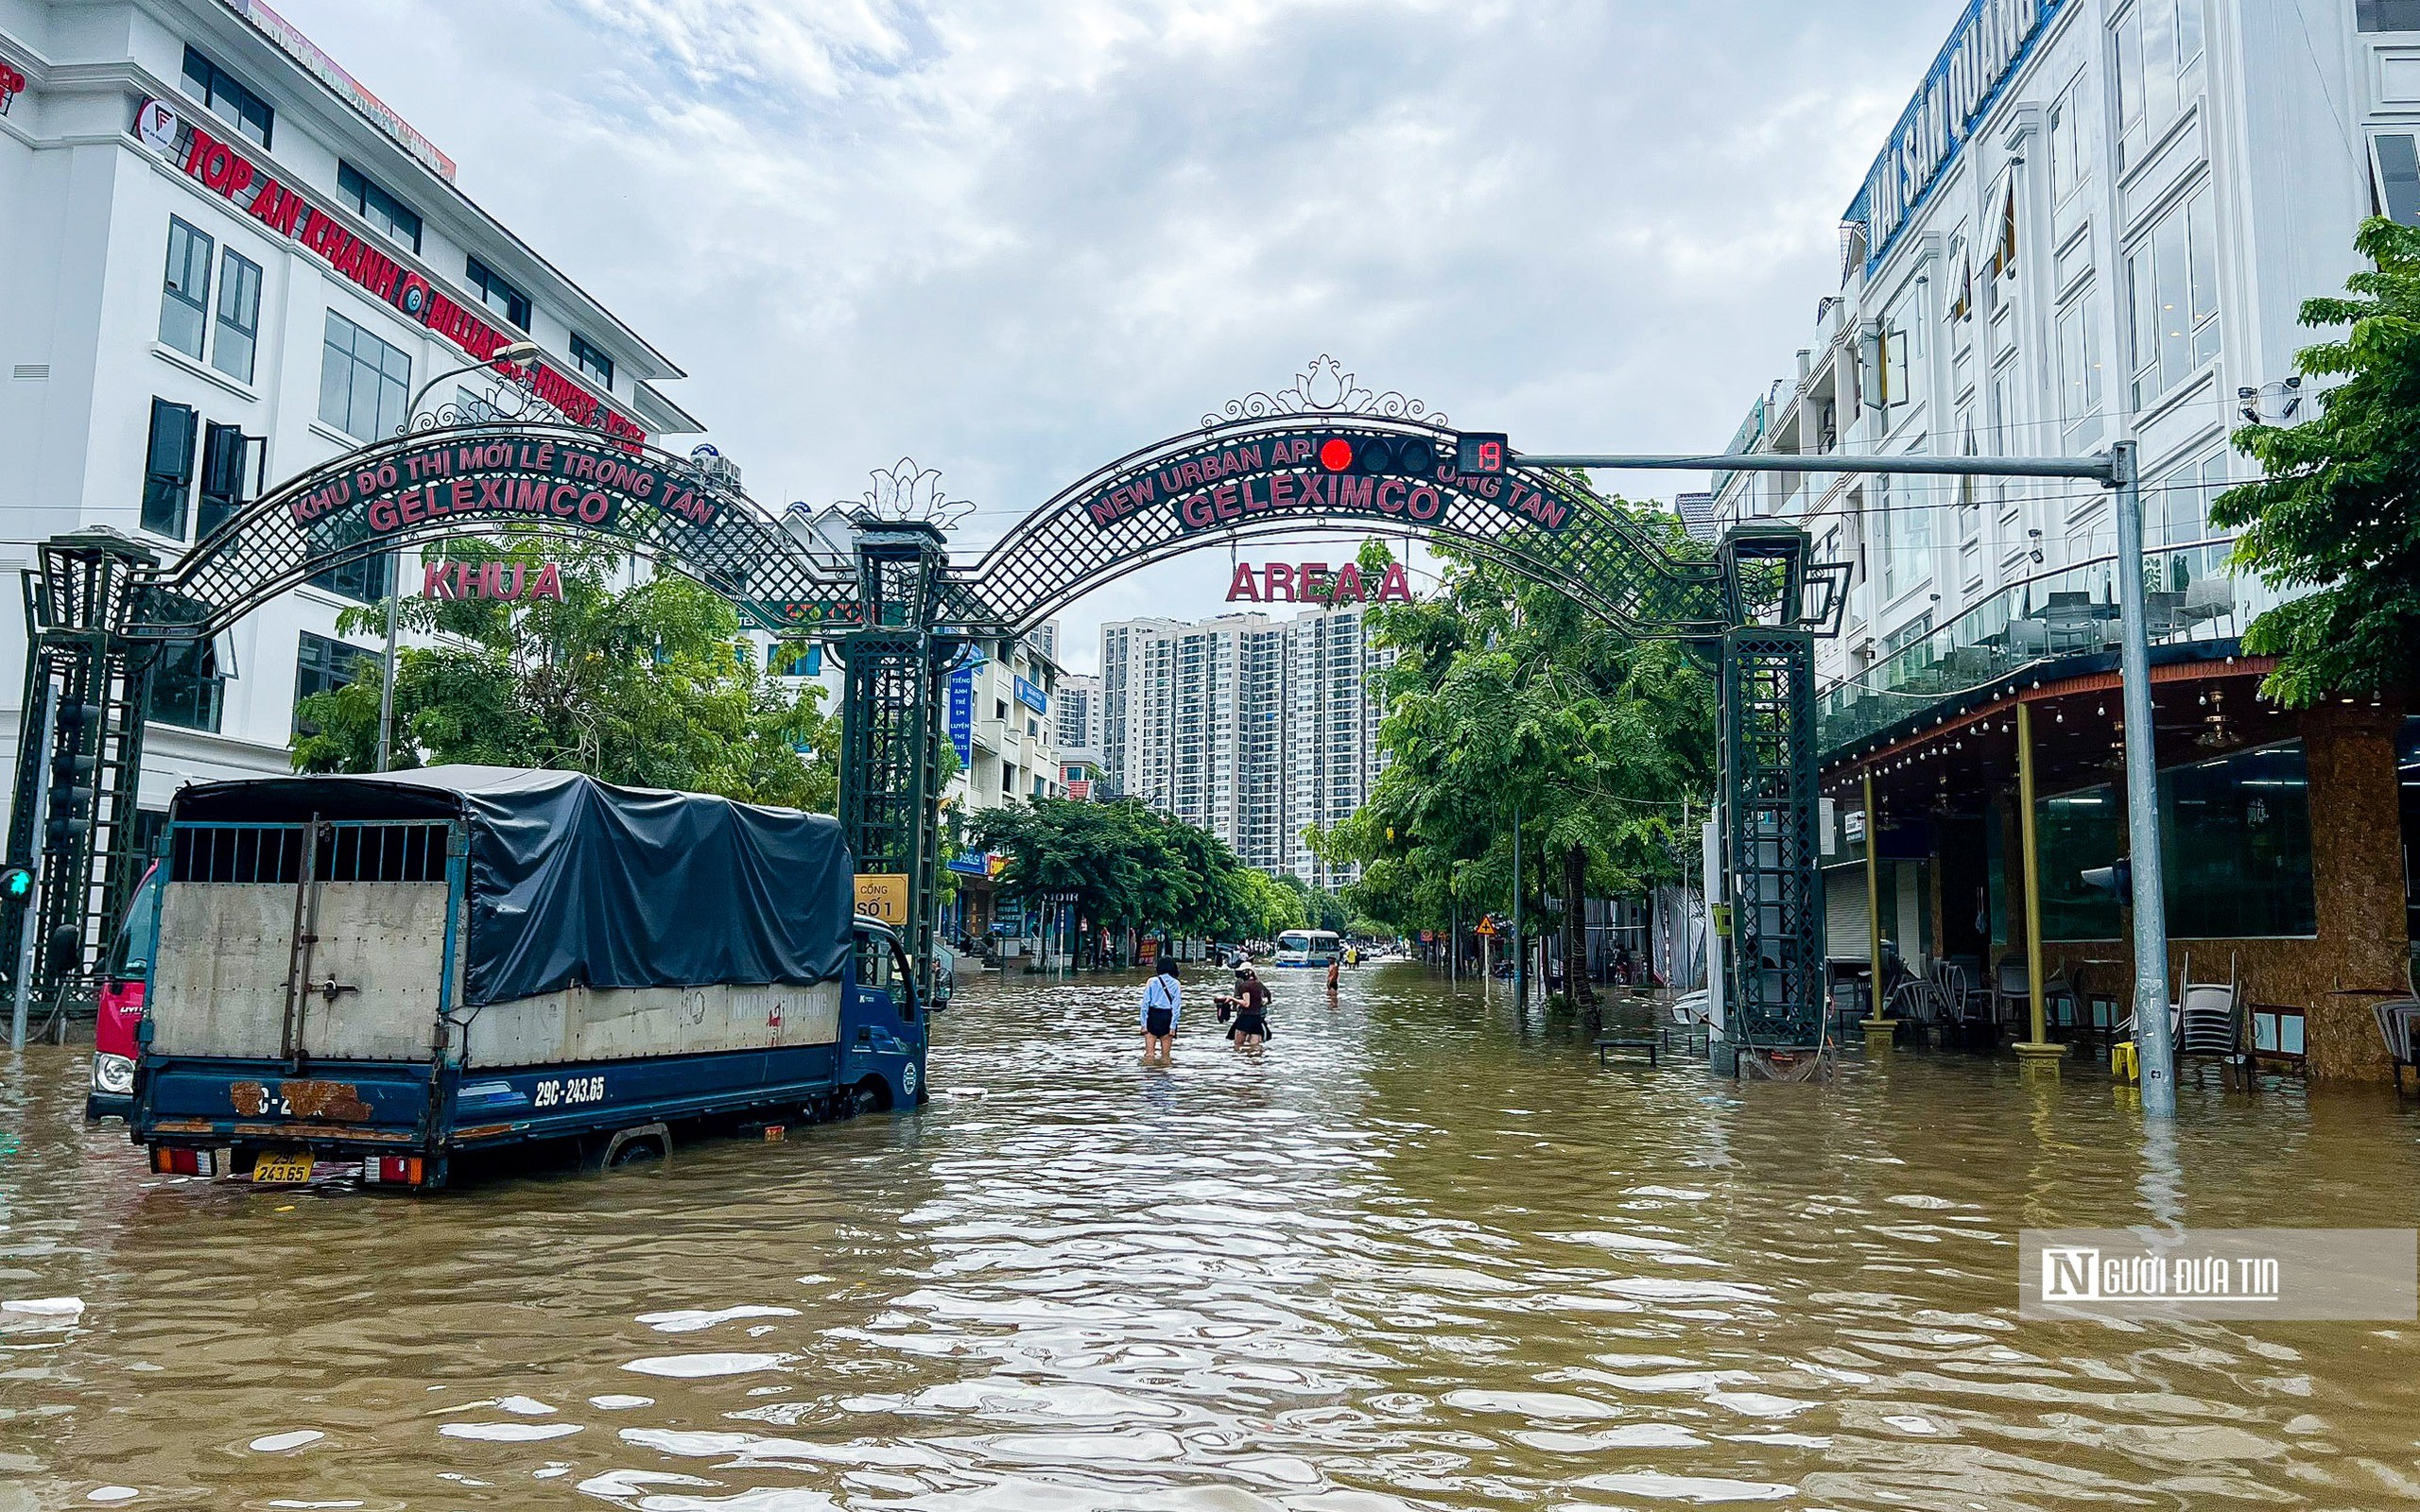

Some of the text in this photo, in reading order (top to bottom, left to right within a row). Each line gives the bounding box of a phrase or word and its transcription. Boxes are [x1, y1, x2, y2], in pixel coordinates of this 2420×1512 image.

[184, 128, 253, 199] TOP
[249, 178, 304, 236] AN
[1478, 441, 1501, 471] 19
[290, 438, 716, 526] KHU ĐÔ THỊ MỚI LÊ TRỌNG TẤN
[1089, 476, 1155, 526] NEW
[1159, 444, 1262, 493] URBAN
[1506, 480, 1566, 529] TAN
[1183, 474, 1439, 527] GELEXIMCO
[368, 477, 610, 532] GELEXIMCO
[423, 561, 564, 602] KHU A
[1227, 562, 1411, 603] AREA A
[856, 898, 891, 916] SỐ 1
[860, 883, 888, 895] CỔNG
[534, 1075, 605, 1107] 29C-243.65
[258, 1166, 305, 1181] 243.65
